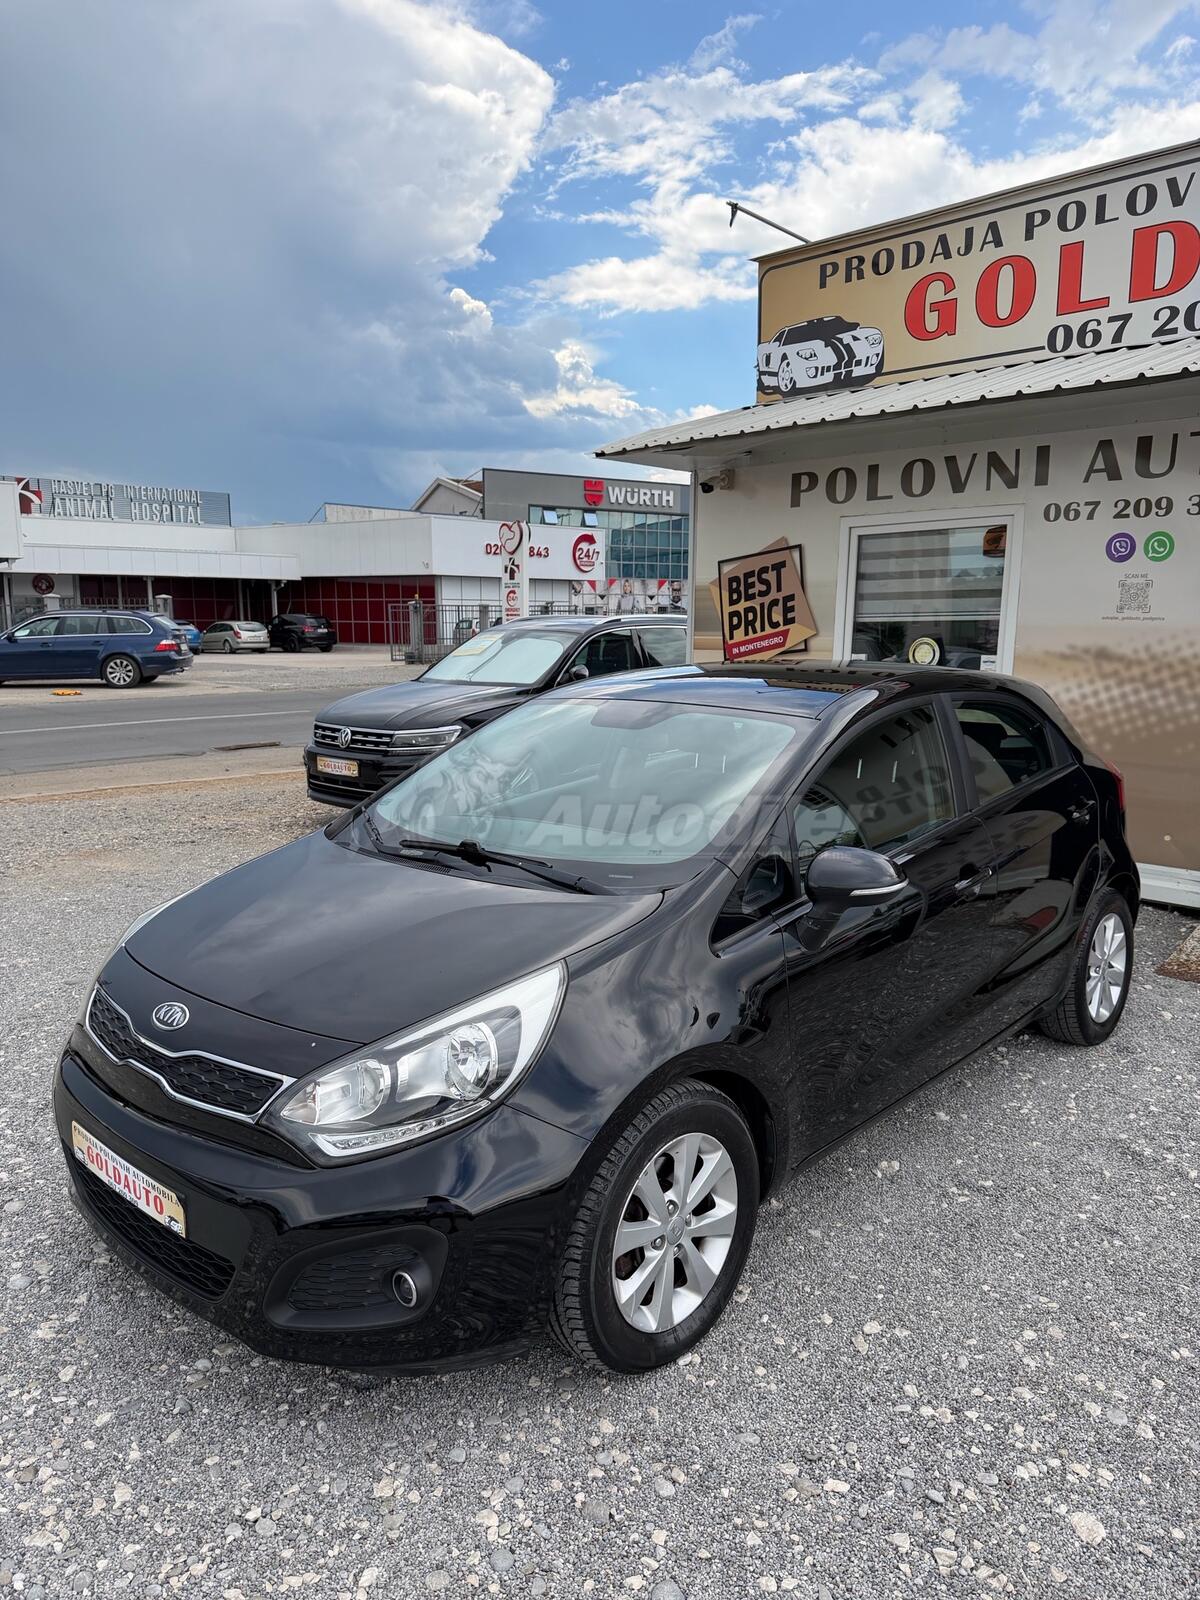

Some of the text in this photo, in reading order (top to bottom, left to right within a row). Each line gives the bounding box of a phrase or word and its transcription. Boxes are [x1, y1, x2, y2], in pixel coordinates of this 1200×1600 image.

[819, 172, 1196, 290] PRODAJA POLOV
[904, 220, 1200, 342] GOLD
[1046, 312, 1133, 354] 067
[51, 479, 203, 504] HASVET PG INTERNATIONAL
[790, 444, 1051, 508] POLOVNI
[53, 497, 205, 525] ANIMAL HOSPITAL
[607, 486, 674, 507] WÜRTH
[1043, 500, 1101, 522] 067
[1112, 496, 1174, 519] 209
[485, 543, 503, 557] 02
[577, 547, 600, 561] 24/7
[727, 560, 787, 607] BEST
[727, 593, 796, 641] PRICE
[732, 636, 784, 655] IN MONTENEGRO
[86, 1144, 164, 1216] GOLDAUTO
